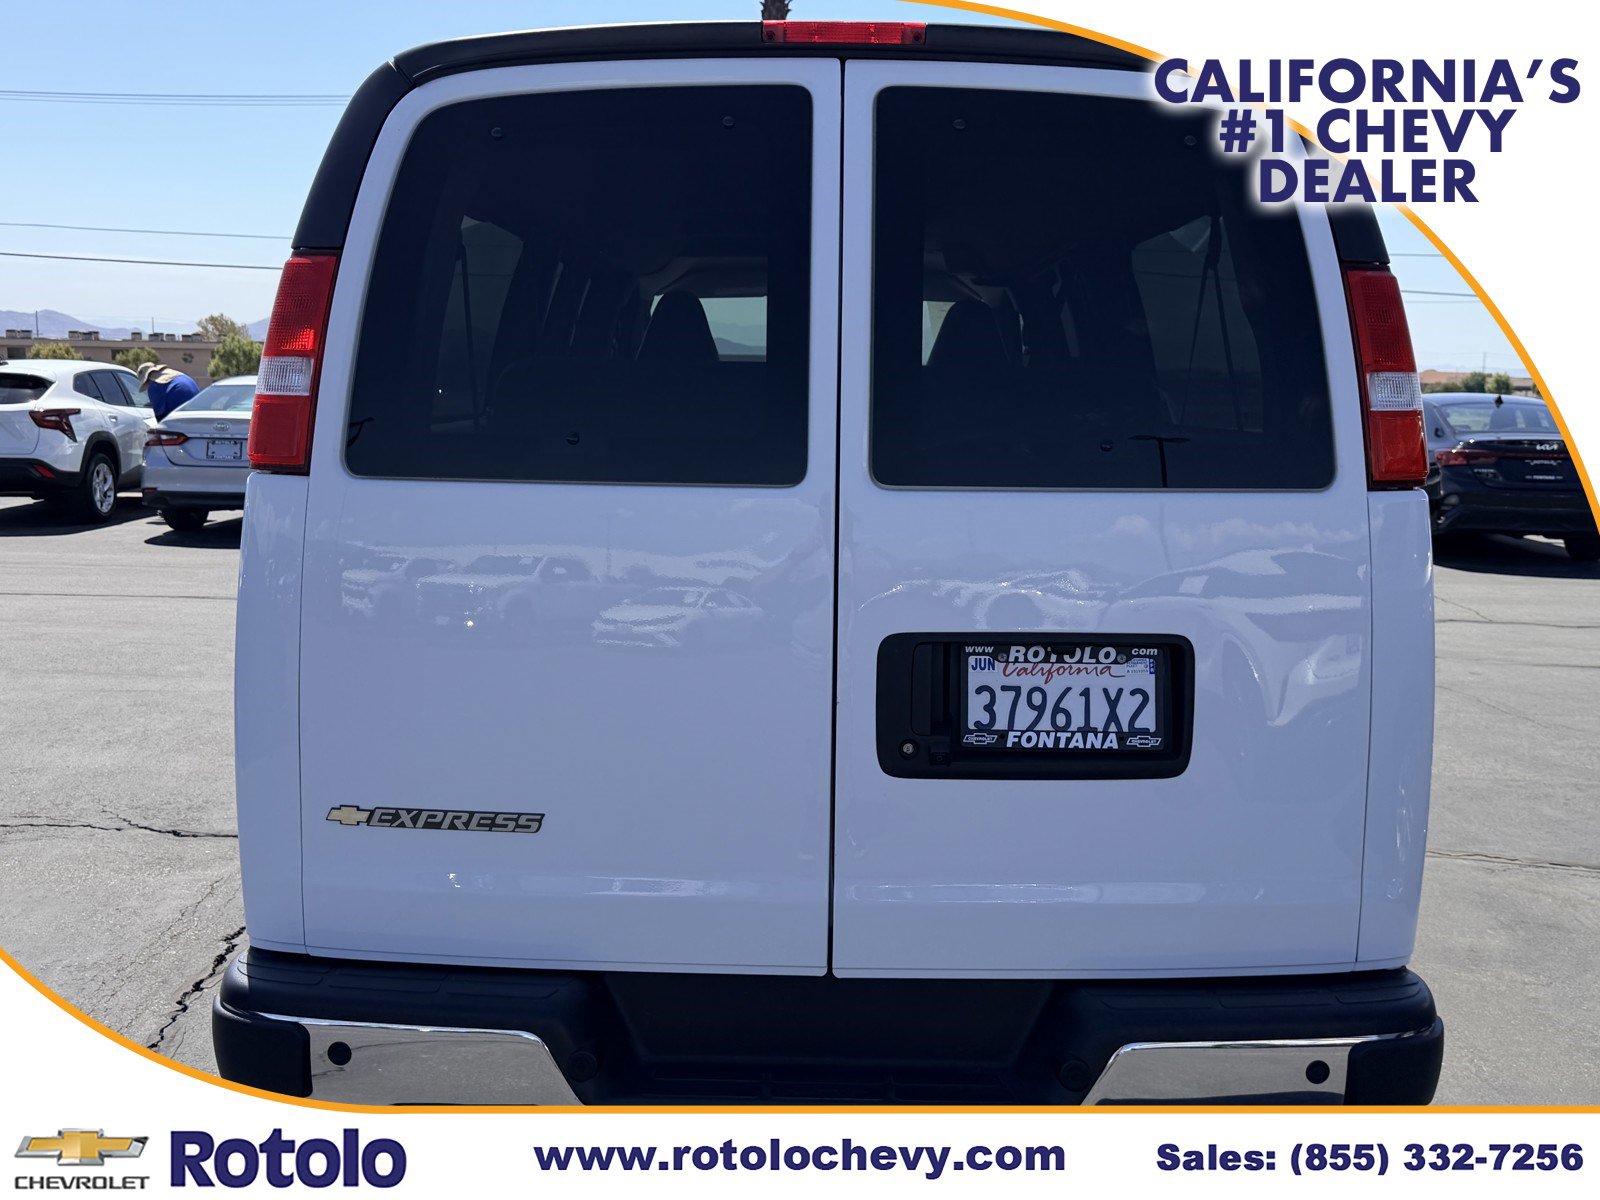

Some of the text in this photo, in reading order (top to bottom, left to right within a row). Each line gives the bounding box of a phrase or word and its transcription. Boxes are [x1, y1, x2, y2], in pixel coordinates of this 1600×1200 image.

[965, 645, 994, 653] www
[1131, 648, 1158, 656] com
[971, 658, 996, 671] JUN
[1002, 662, 1126, 685] California
[973, 685, 1150, 732] 37961X2
[1006, 731, 1119, 749] FONTANA
[368, 807, 543, 833] EXPRESS
